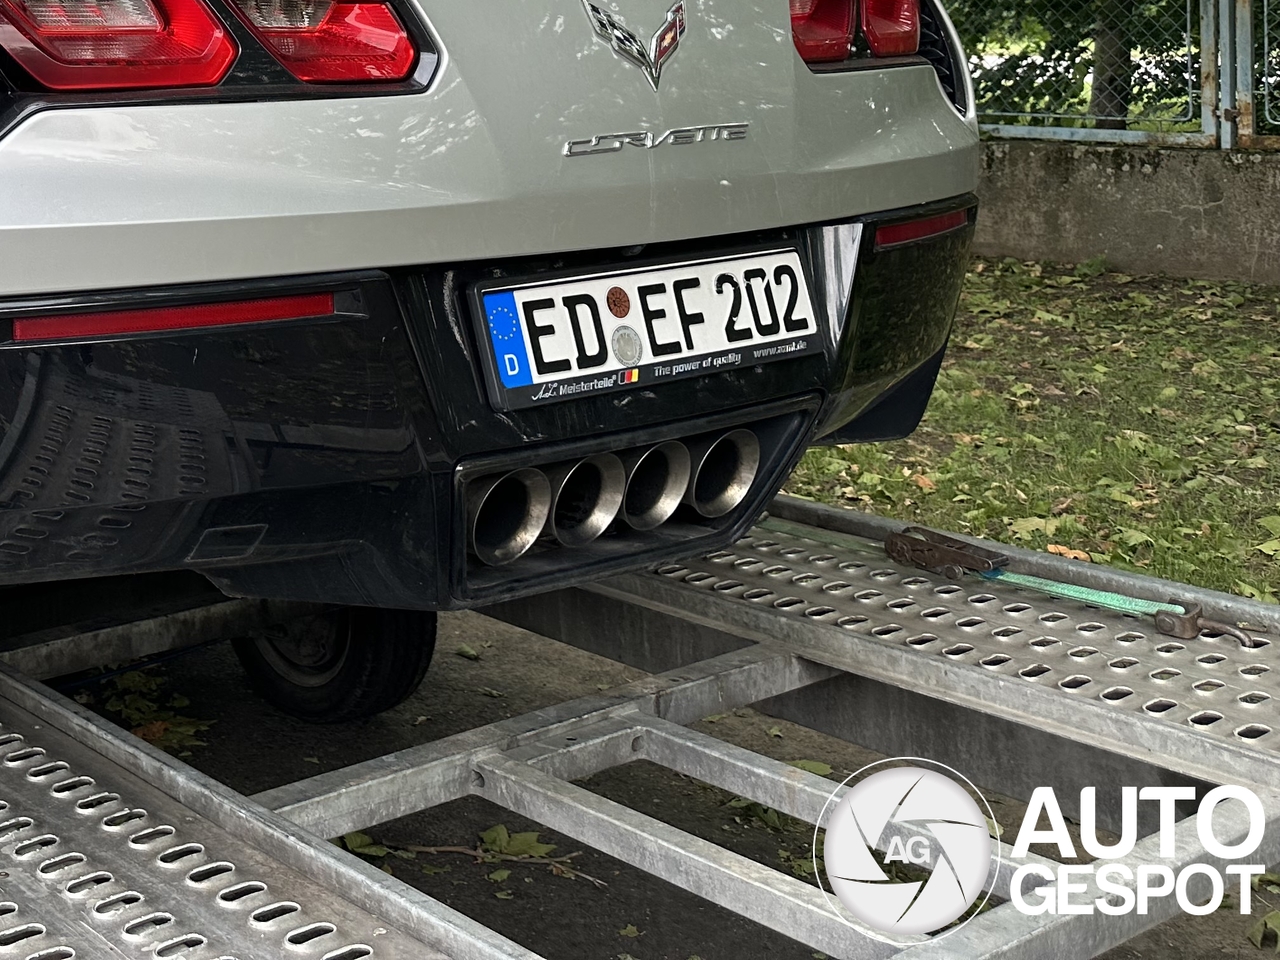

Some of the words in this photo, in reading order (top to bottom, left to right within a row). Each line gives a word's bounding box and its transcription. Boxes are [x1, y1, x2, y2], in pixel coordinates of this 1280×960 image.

[561, 123, 749, 157] CORVETTE
[522, 293, 608, 375] ED
[637, 278, 704, 356] EF
[715, 264, 809, 342] 202
[505, 353, 520, 376] D
[654, 366, 671, 377] The
[672, 361, 701, 375] power
[702, 357, 712, 367] of
[713, 352, 742, 368] quality
